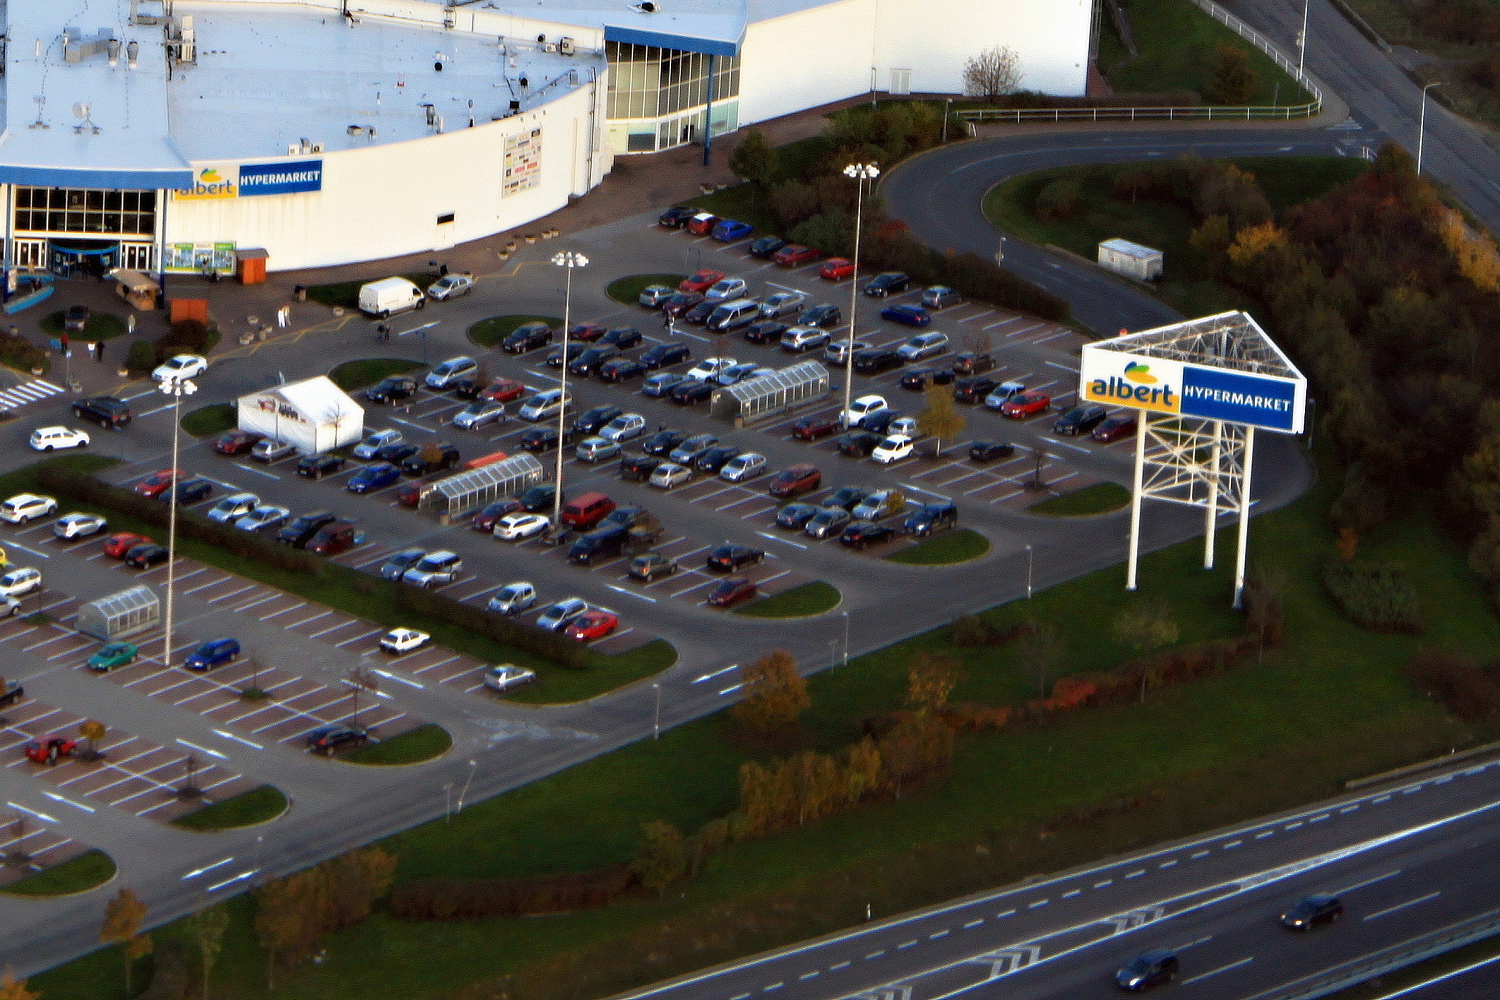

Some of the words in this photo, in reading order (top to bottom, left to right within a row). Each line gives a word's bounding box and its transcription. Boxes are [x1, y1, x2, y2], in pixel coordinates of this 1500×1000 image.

[240, 170, 321, 187] HYPERMARKET
[1091, 375, 1174, 407] albert
[1184, 384, 1292, 413] HYPERMARKET
